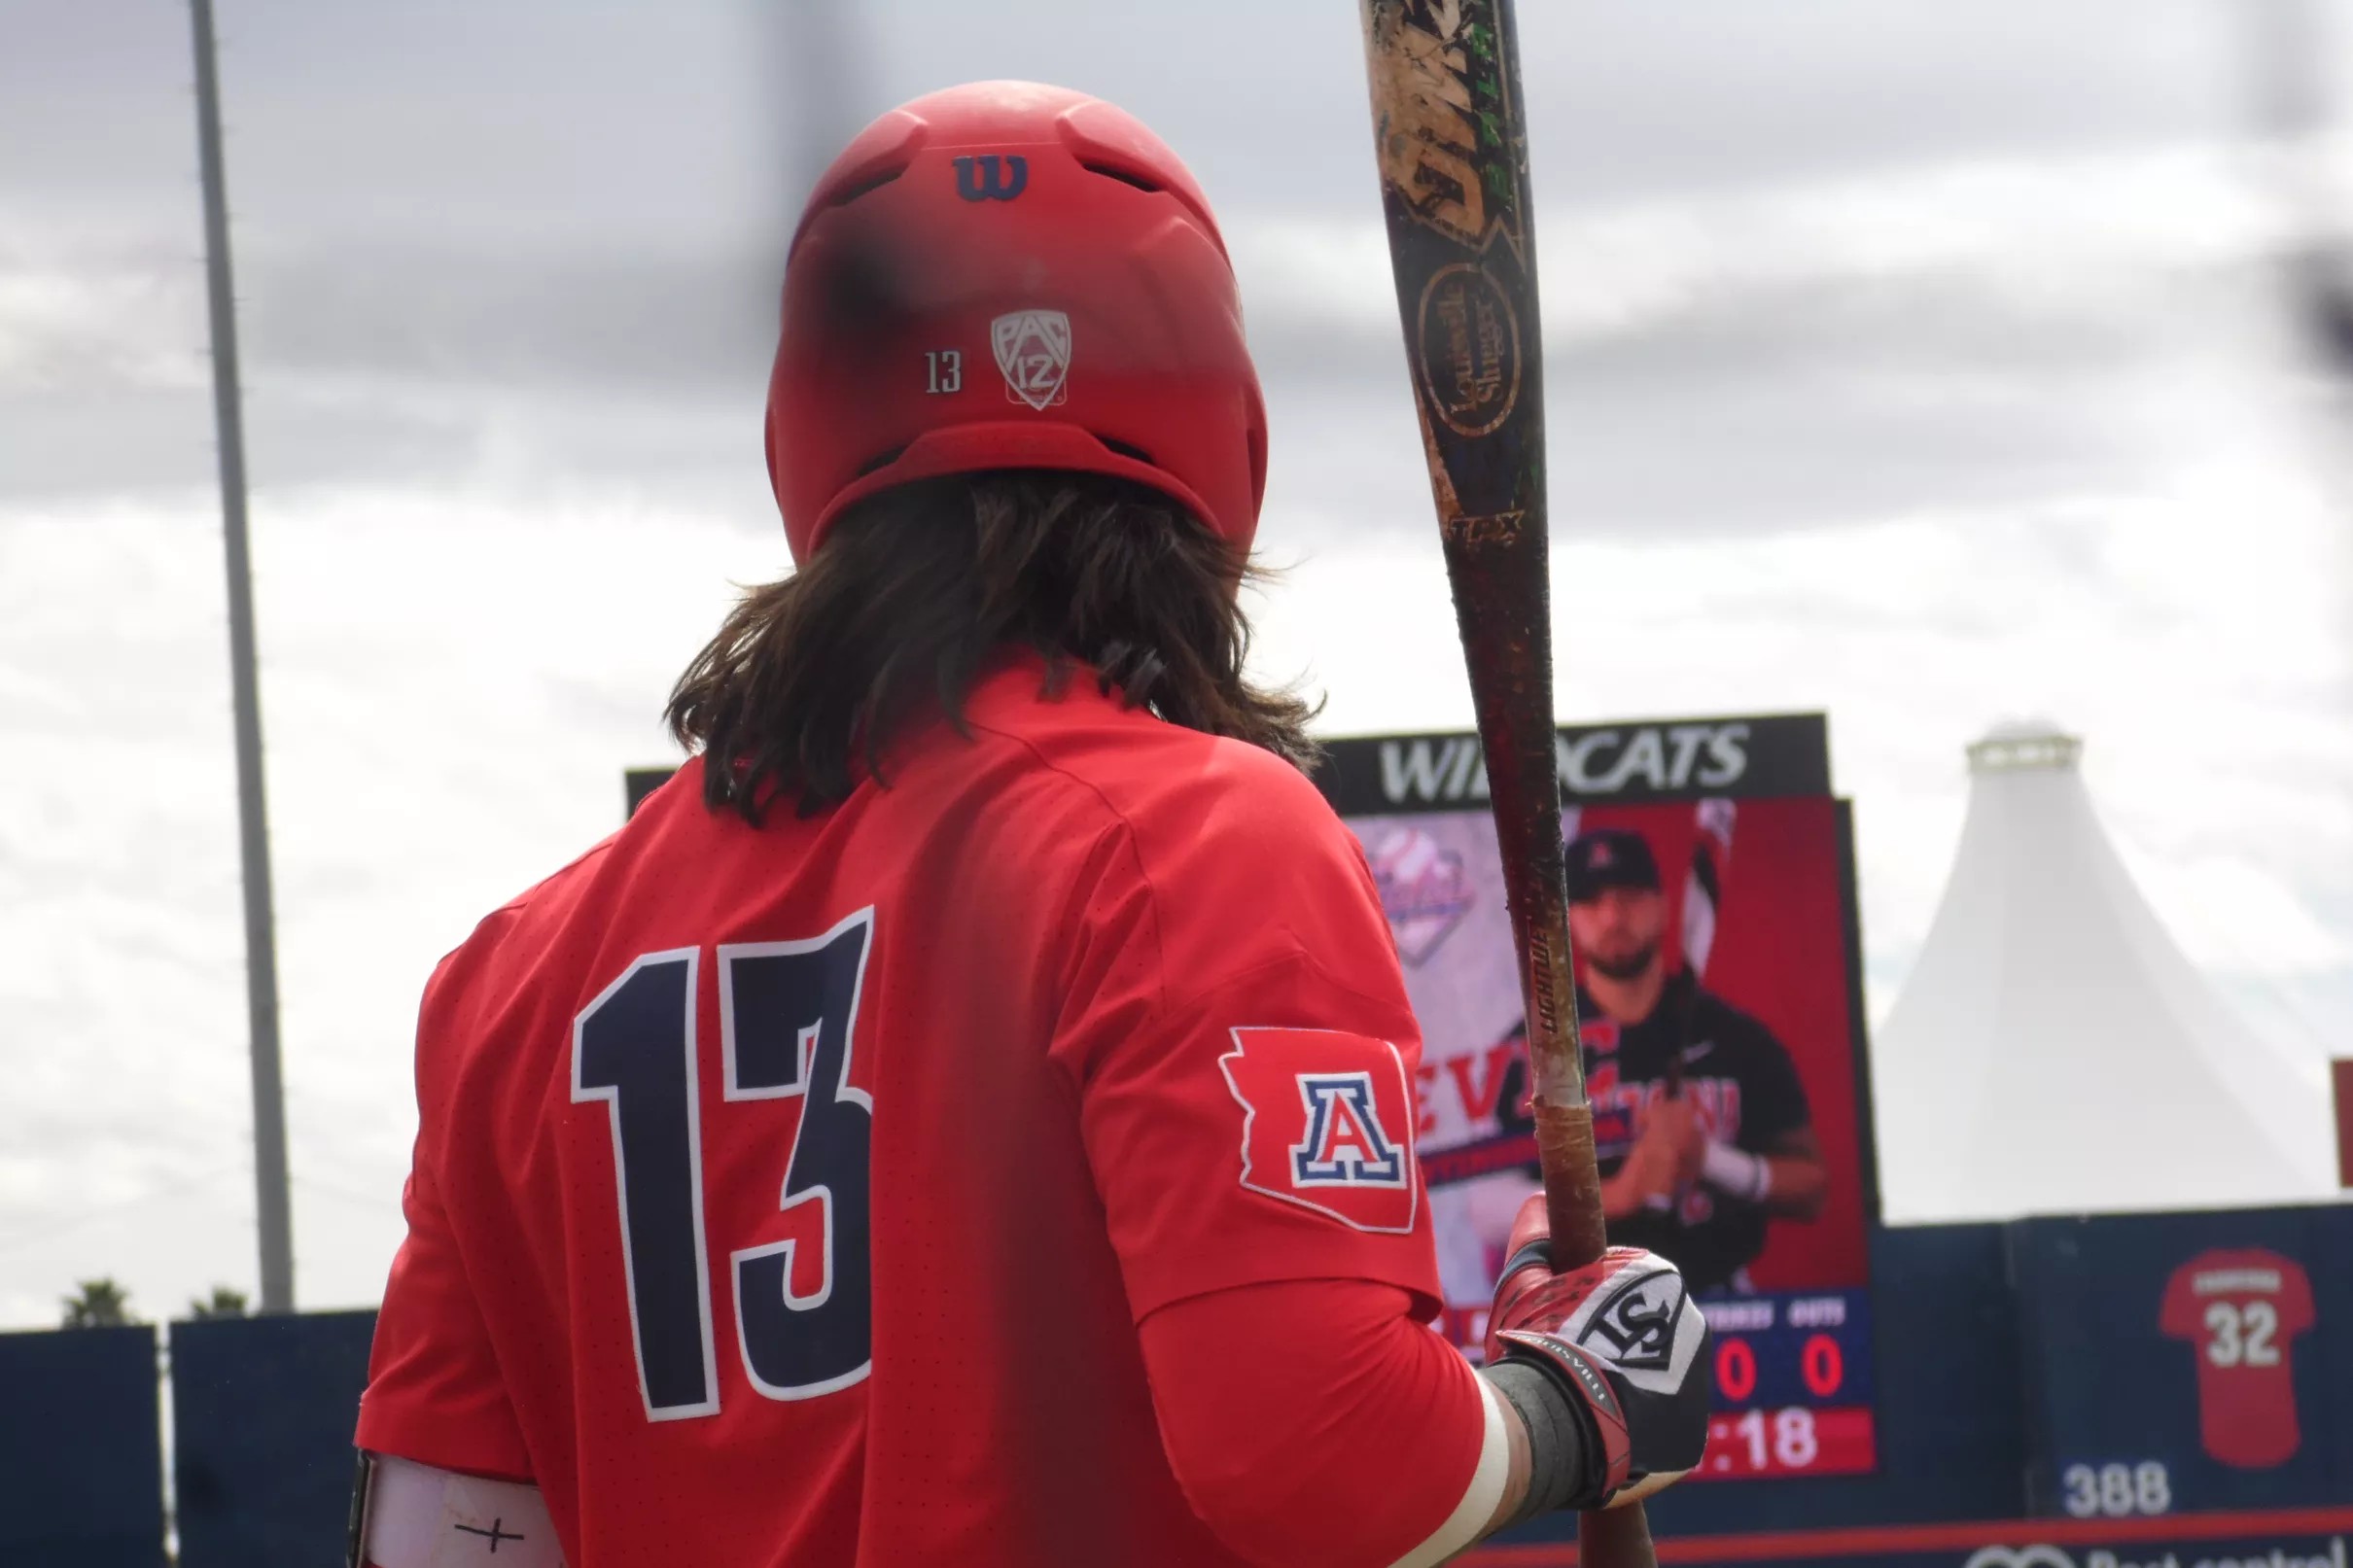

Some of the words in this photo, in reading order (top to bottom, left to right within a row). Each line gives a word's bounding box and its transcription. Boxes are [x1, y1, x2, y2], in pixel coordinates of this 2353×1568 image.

[926, 351, 962, 394] 13
[1017, 354, 1058, 390] 12
[571, 904, 874, 1422] 13
[1288, 1071, 1407, 1190] A
[1715, 1338, 1757, 1402] 0
[1802, 1333, 1844, 1398] 0
[2204, 1301, 2281, 1368] 32
[2063, 1461, 2171, 1518] 388
